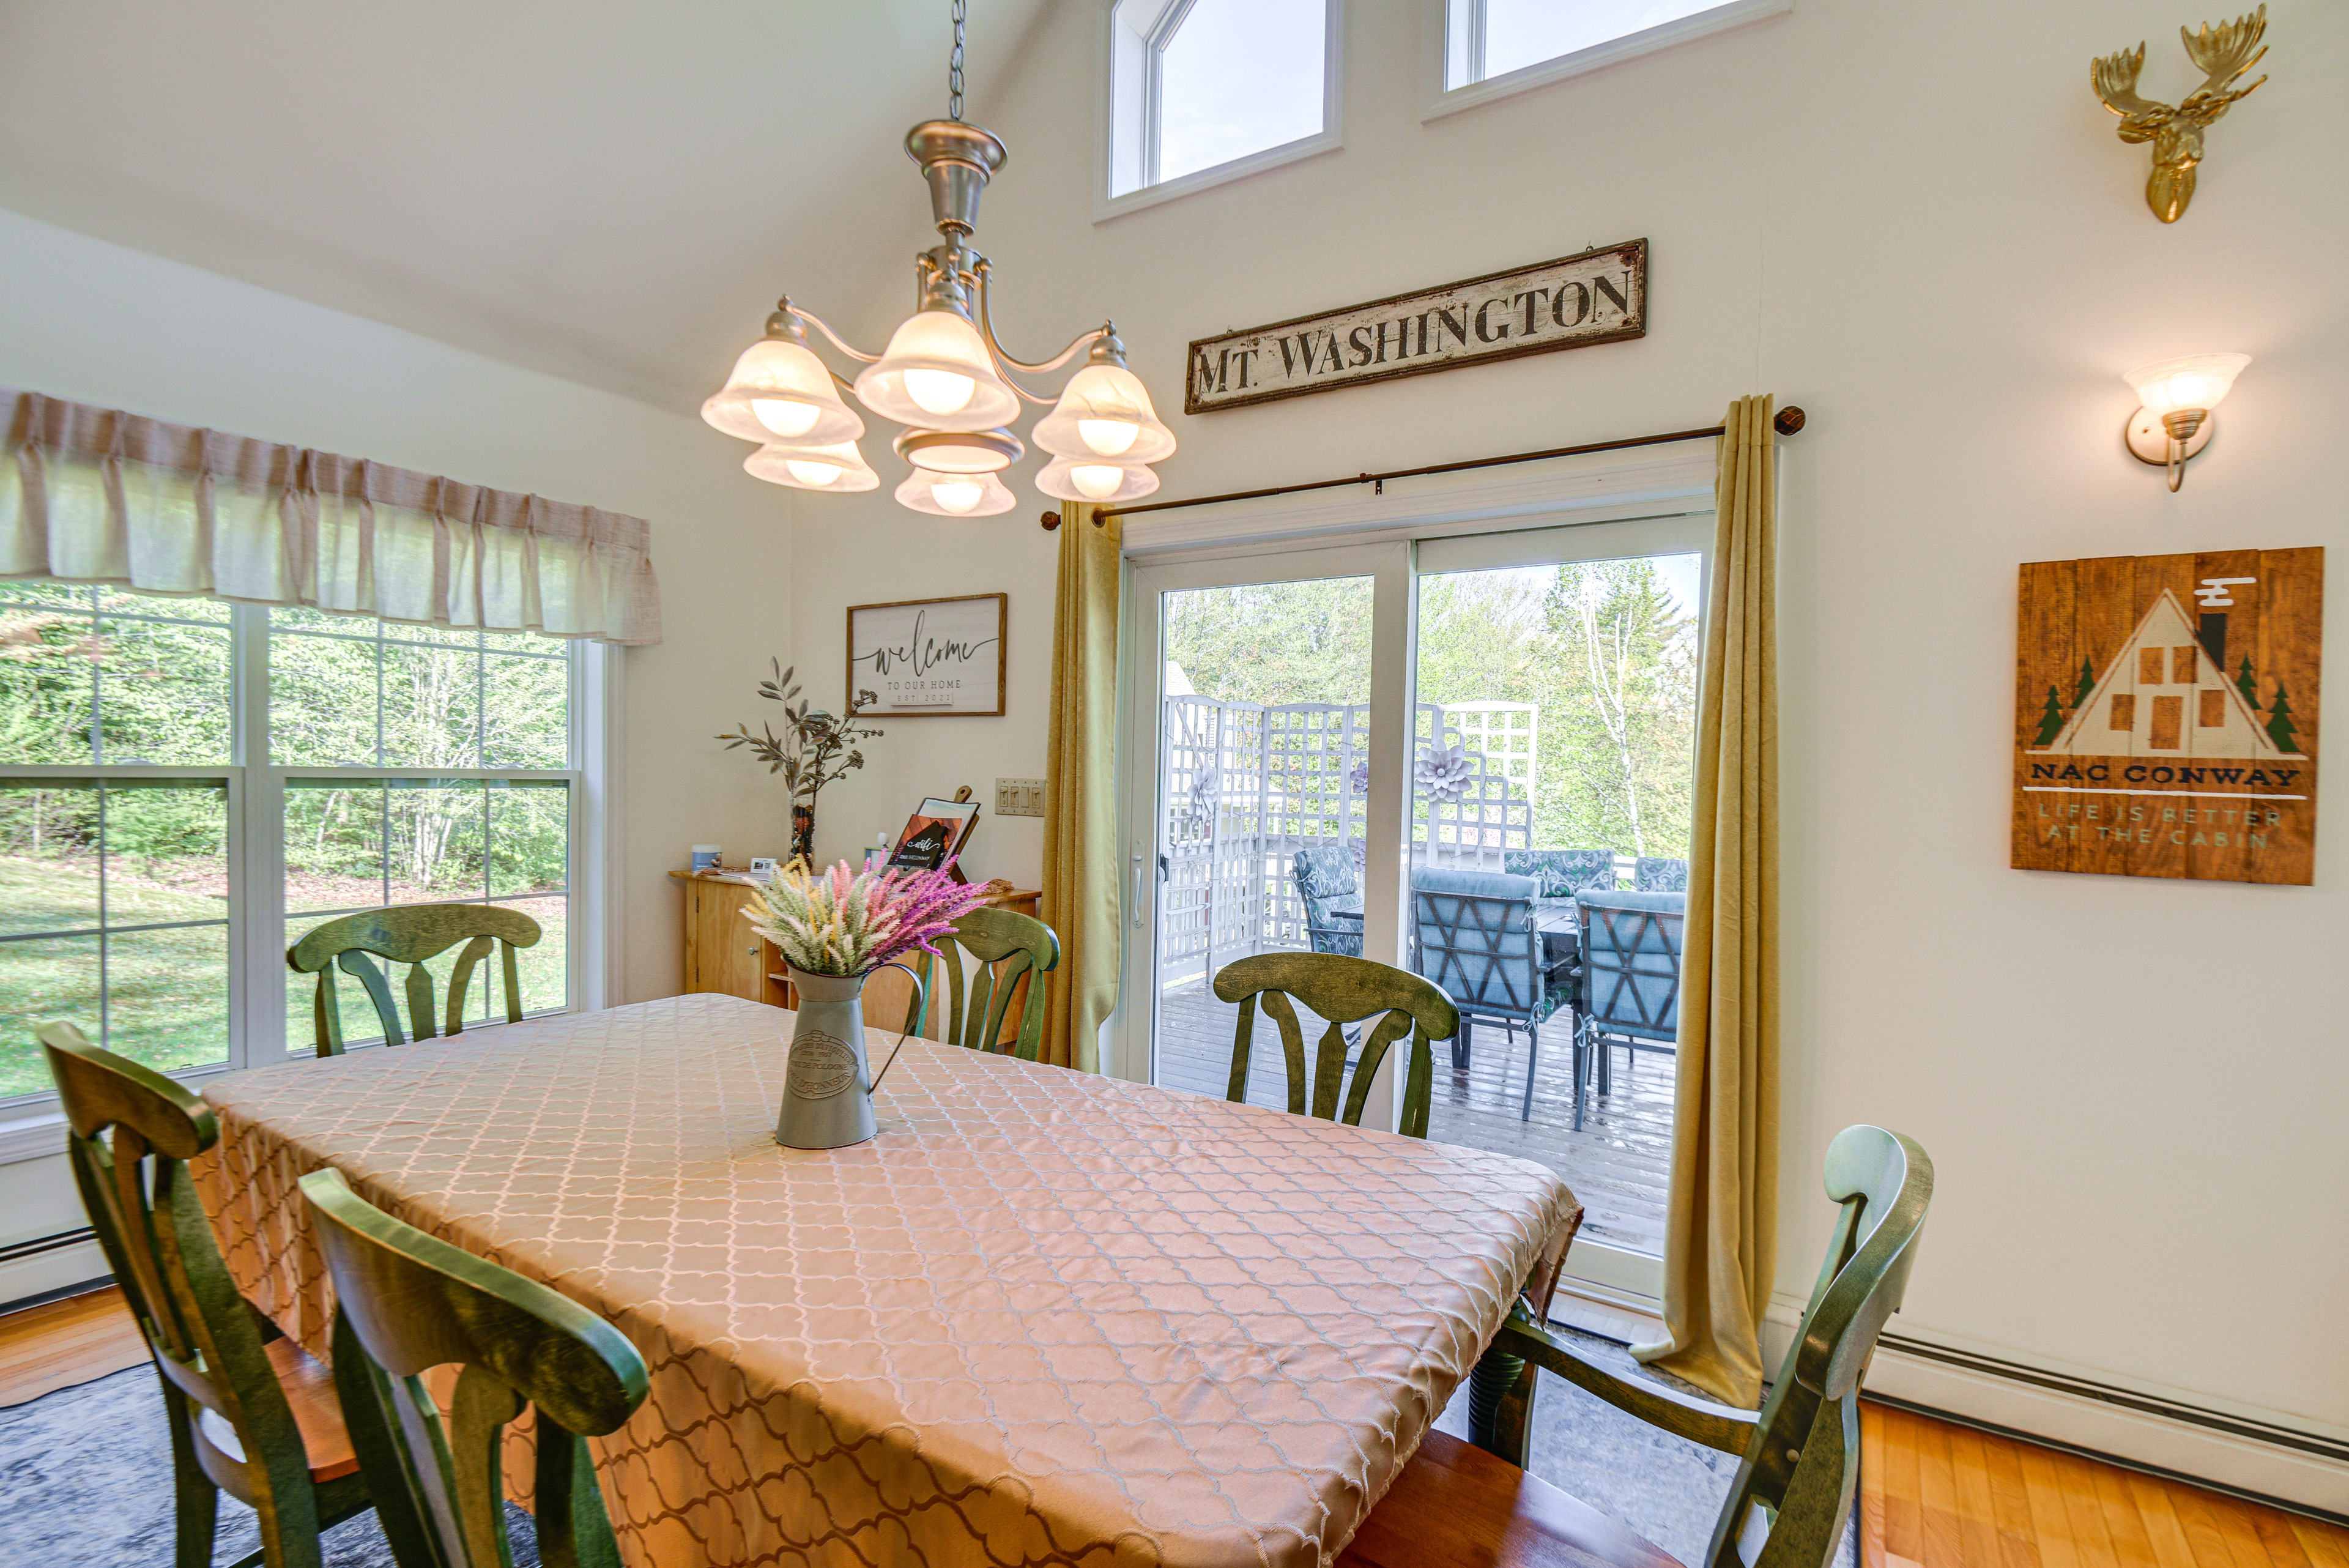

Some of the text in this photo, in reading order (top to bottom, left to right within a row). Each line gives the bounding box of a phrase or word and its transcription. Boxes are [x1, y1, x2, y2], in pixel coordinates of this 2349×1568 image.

[1198, 270, 1631, 393] MT. WASHINGTON
[852, 609, 999, 677] welcome
[887, 680, 961, 690] TO OUR HOME
[2032, 763, 2300, 787] NAC CONWAY
[2038, 803, 2282, 828] LIFE IS BETTER
[2047, 824, 2268, 849] AT THE CABIN
